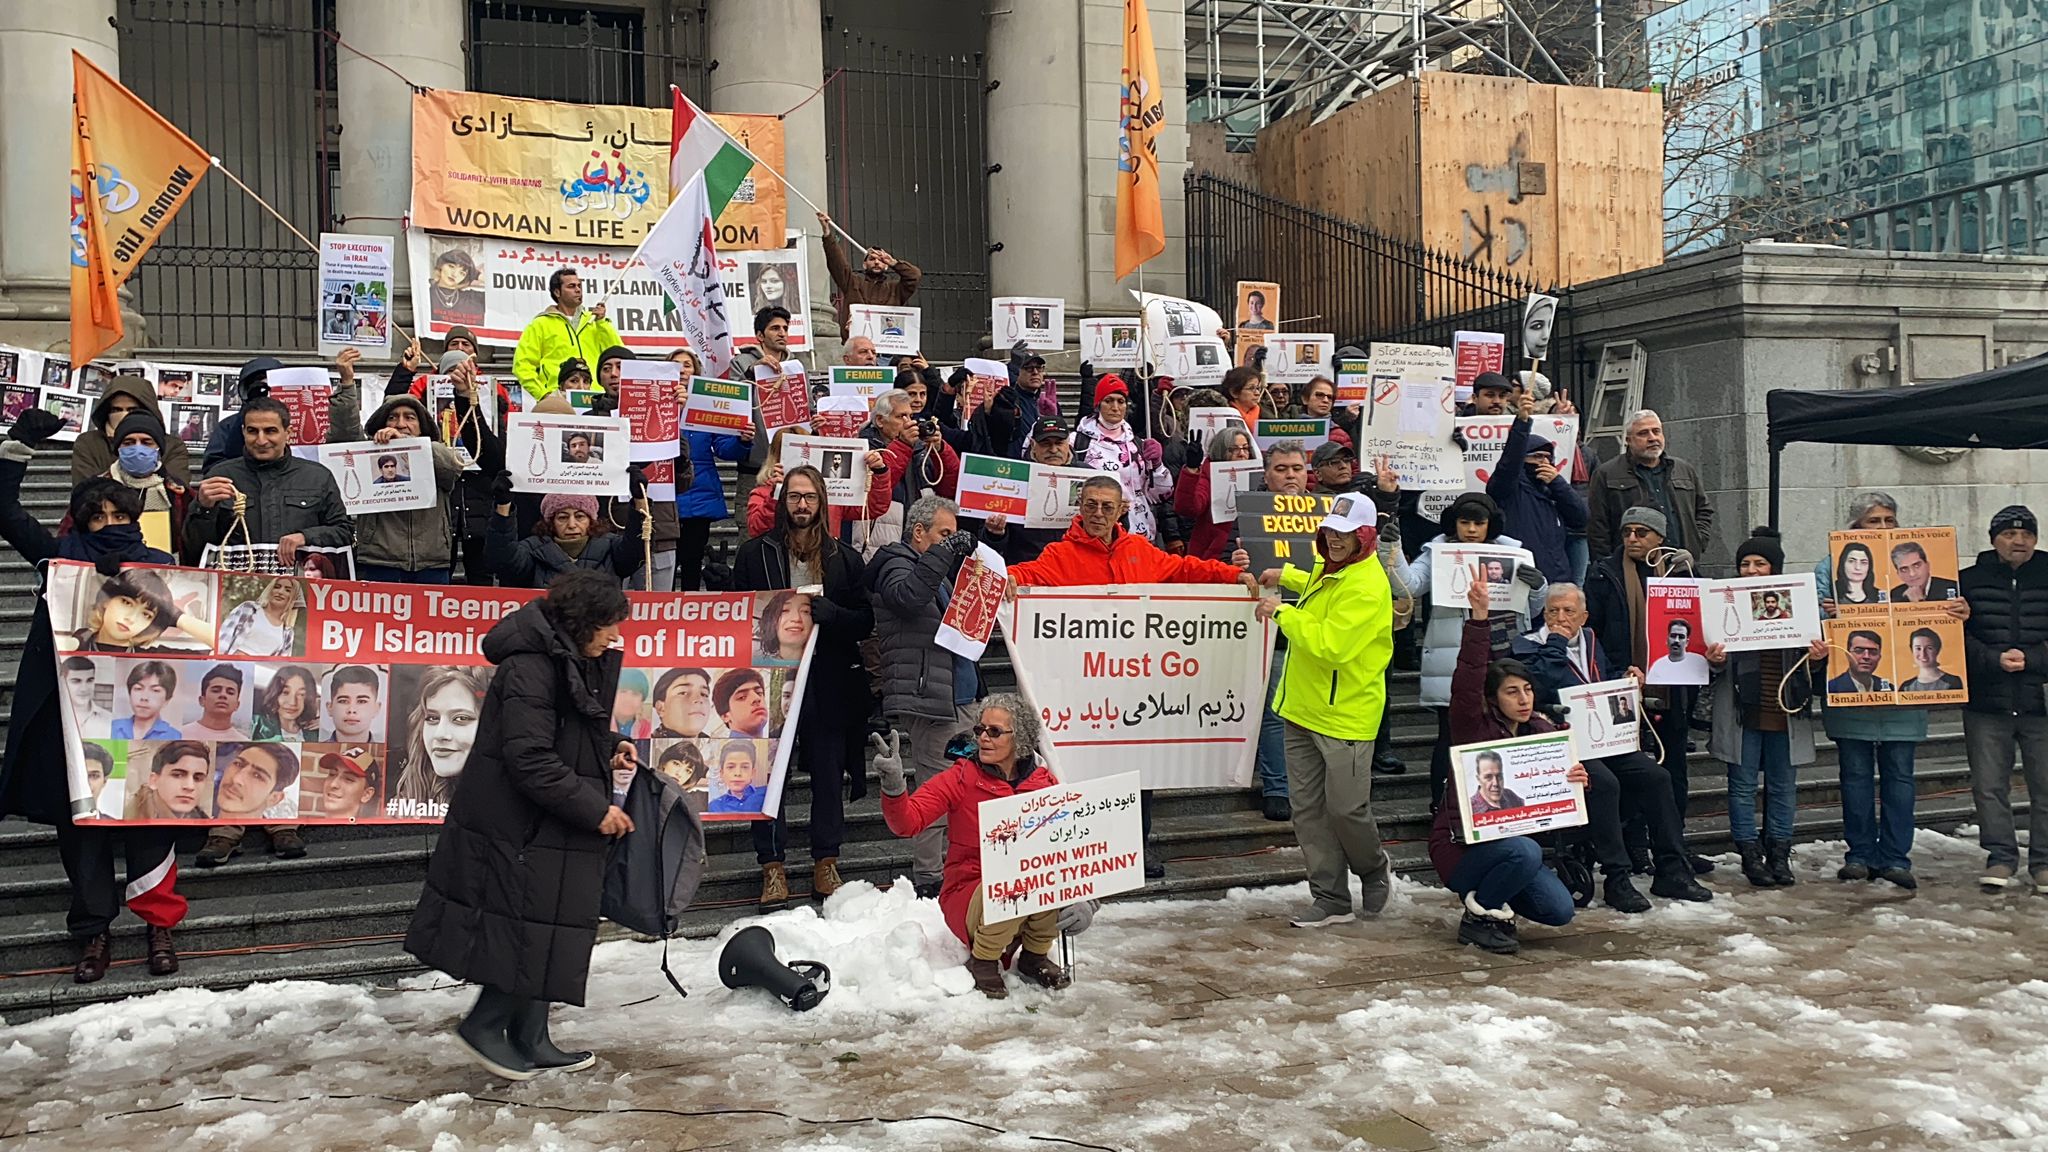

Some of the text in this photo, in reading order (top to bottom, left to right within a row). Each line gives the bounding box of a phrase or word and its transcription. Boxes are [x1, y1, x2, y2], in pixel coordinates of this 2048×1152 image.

[448, 171, 543, 188] SOLIDARITY WITH IRANIANS
[446, 206, 551, 235] WOMAN
[575, 219, 625, 240] LIFE
[348, 244, 383, 253] EXECUTION
[493, 272, 663, 296] DOWN TH ISLAMI
[1378, 345, 1401, 357] STOP
[845, 370, 883, 379] FEMME
[704, 382, 740, 396] FEMME
[856, 386, 874, 395] VIE
[713, 400, 730, 410] VIE
[694, 412, 741, 426] LIBERTÉ
[1269, 424, 1315, 433] WOMAN
[997, 463, 1011, 474] زن
[985, 499, 1013, 511] آزادی
[1274, 495, 1316, 513] STOP
[1263, 515, 1326, 533] EXECUT
[1844, 533, 1858, 541] her
[1911, 531, 1924, 539] his
[1927, 531, 1951, 539] voice
[1274, 540, 1290, 557] IN
[1650, 587, 1668, 598] STOP
[310, 584, 528, 621] Young Teena
[626, 597, 750, 621] urdered
[1666, 599, 1691, 609] IN IRAN
[1033, 612, 1248, 646] Islamic Regime
[322, 620, 363, 657] By
[635, 629, 667, 657] of
[677, 629, 735, 657] Iran
[1742, 634, 1777, 642] EXECUTIONS
[1083, 651, 1200, 678] Must Go
[1831, 693, 1893, 704] Ismail Abdi
[1080, 697, 1119, 729] باید
[1122, 692, 1190, 727] اسلامی
[1198, 689, 1245, 728] رژیم
[386, 798, 450, 817] #Mahs
[1021, 791, 1083, 813] جنایت کاران
[1099, 800, 1112, 812] باد
[1114, 792, 1136, 810] نابود
[1073, 805, 1096, 820] رژیم
[1050, 825, 1090, 842] در ایران
[1020, 841, 1108, 872] DOWN WITH
[988, 852, 1138, 899] ISLAMIC TYRANNY
[1039, 882, 1094, 906] IN IRAN
